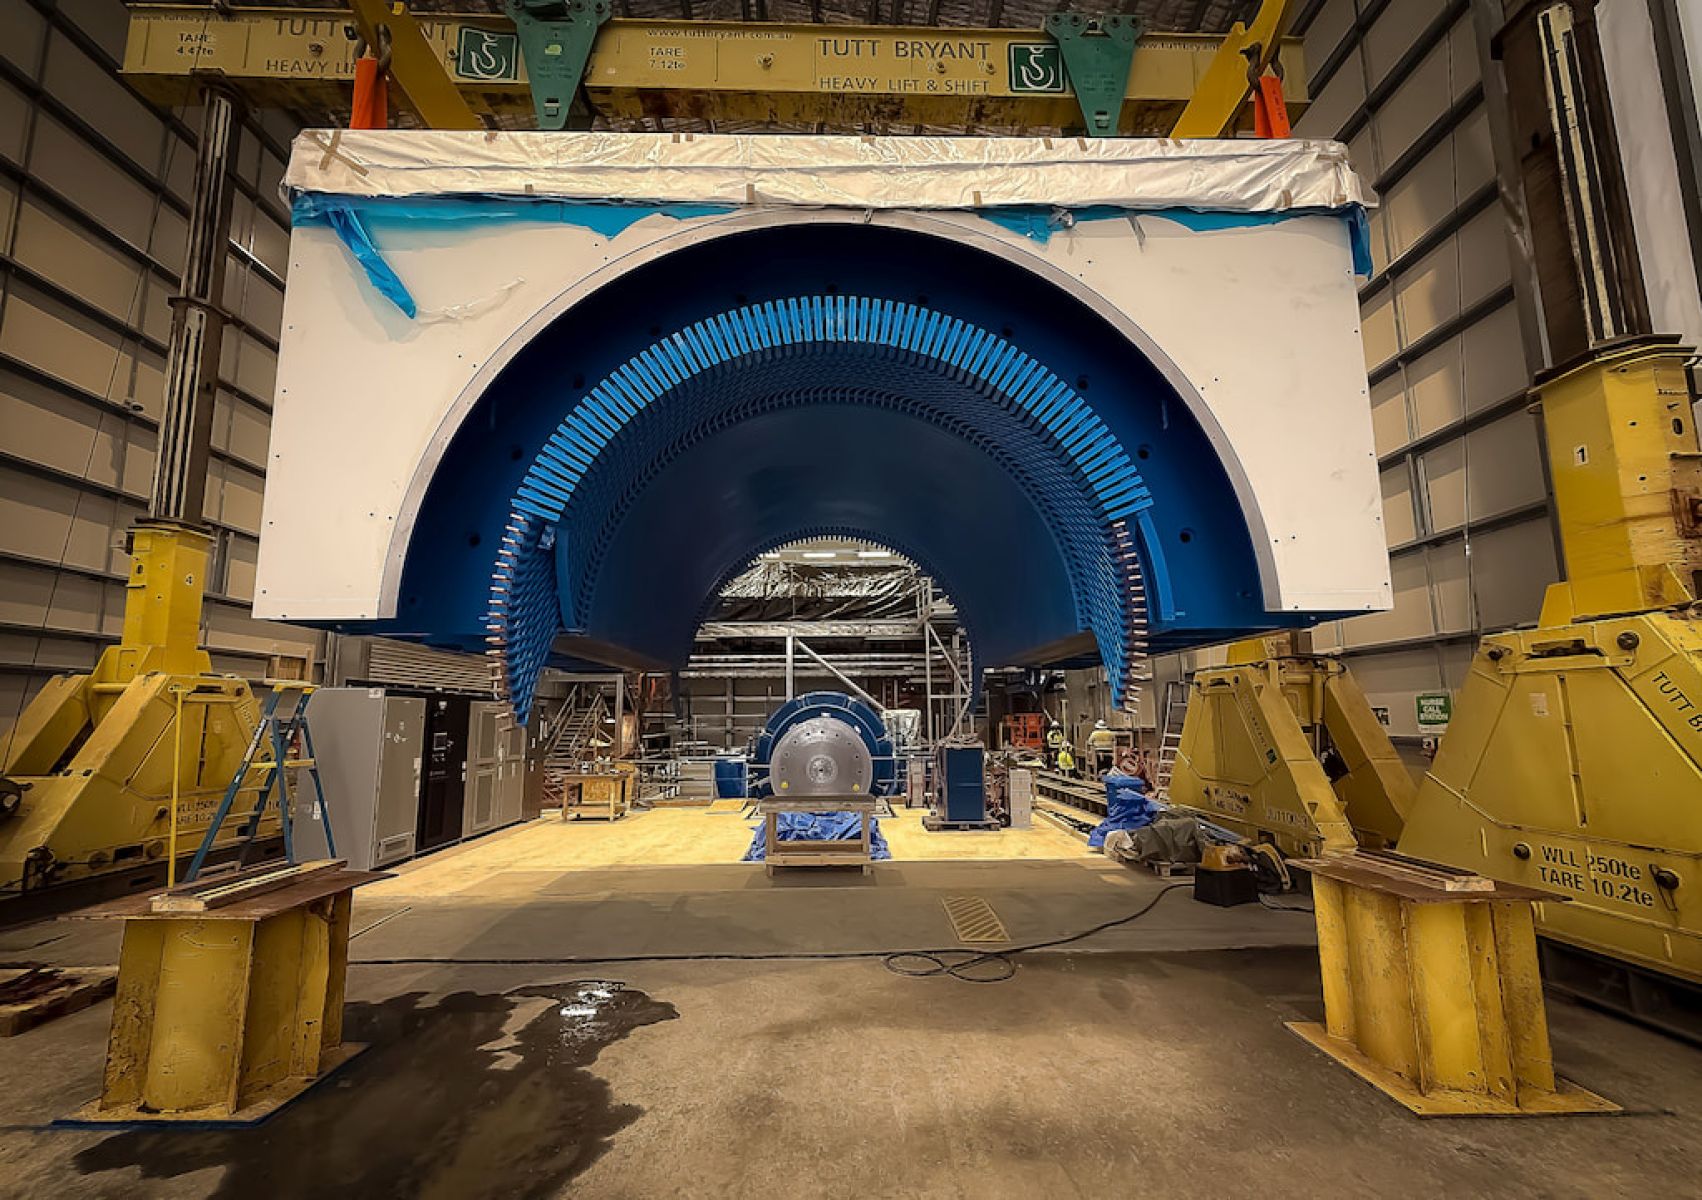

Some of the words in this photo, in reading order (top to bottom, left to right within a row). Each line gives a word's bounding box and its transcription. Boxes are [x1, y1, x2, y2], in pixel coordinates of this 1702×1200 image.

[273, 17, 340, 37] TUTT
[817, 39, 881, 57] TUTT
[895, 41, 991, 60] BRYANT
[265, 59, 329, 74] HEAVY
[820, 77, 878, 90] HEAVY
[888, 79, 920, 92] LIFT
[926, 79, 938, 92] &
[945, 79, 990, 93] SHIFT
[1576, 446, 1585, 463] 1
[1652, 670, 1696, 711] TUTT
[1541, 845, 1581, 869] WLL
[1585, 854, 1641, 881] 250te
[1540, 866, 1585, 893] TARE
[1593, 878, 1653, 907] 10.2te
